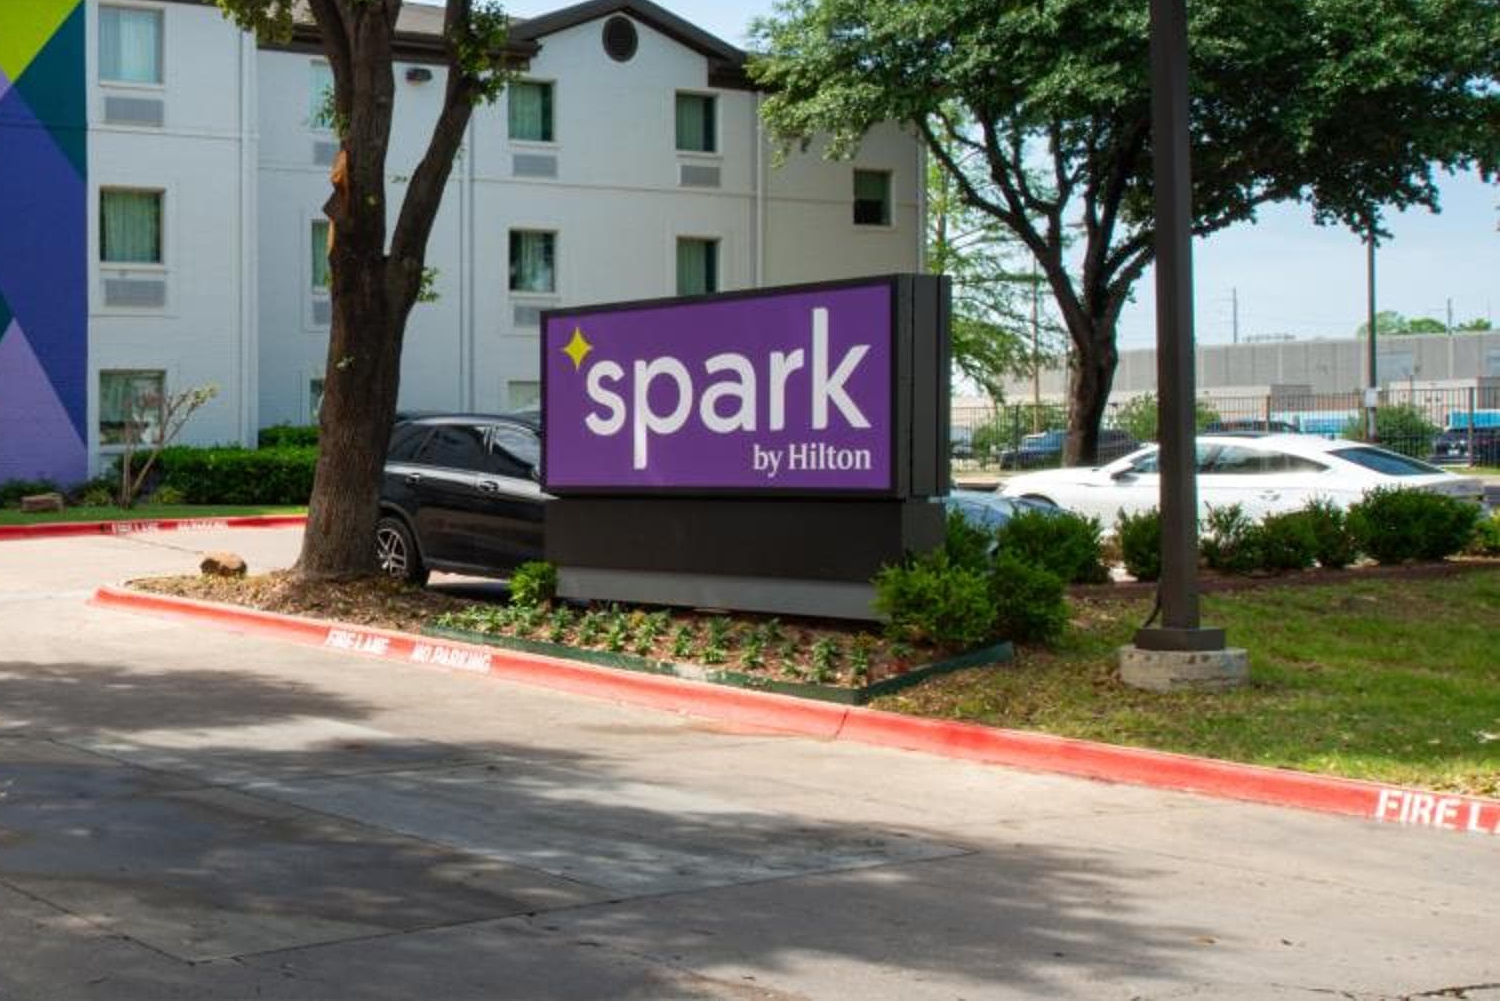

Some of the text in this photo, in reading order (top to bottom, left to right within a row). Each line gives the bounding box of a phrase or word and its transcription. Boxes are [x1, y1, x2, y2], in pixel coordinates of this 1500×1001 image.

[585, 307, 871, 469] spark
[753, 443, 872, 477] by Hilton
[1376, 790, 1500, 835] FIRE L
